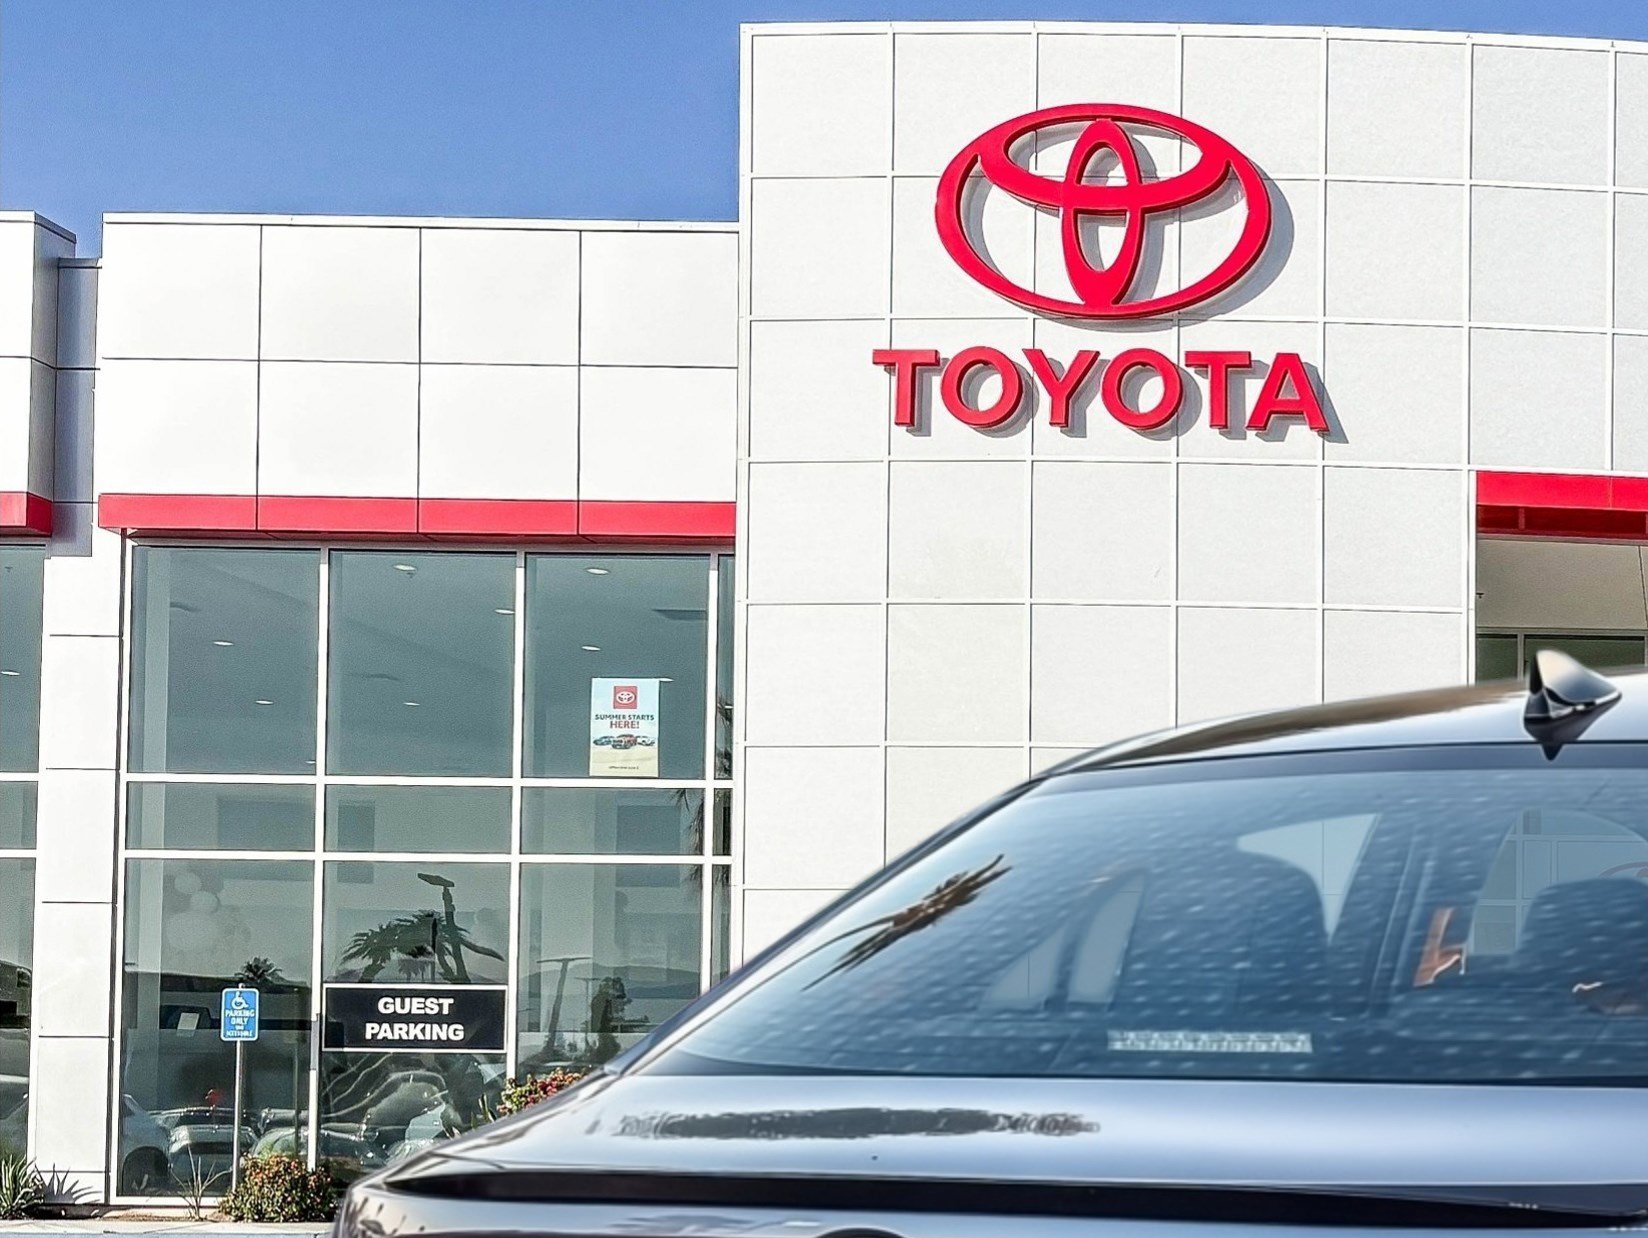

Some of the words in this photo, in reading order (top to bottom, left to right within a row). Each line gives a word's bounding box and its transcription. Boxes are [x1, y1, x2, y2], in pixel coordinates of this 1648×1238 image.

[872, 346, 1330, 433] TOYOTA
[610, 721, 640, 729] HERE!
[377, 997, 454, 1015] GUEST
[365, 1023, 465, 1041] PARKING
